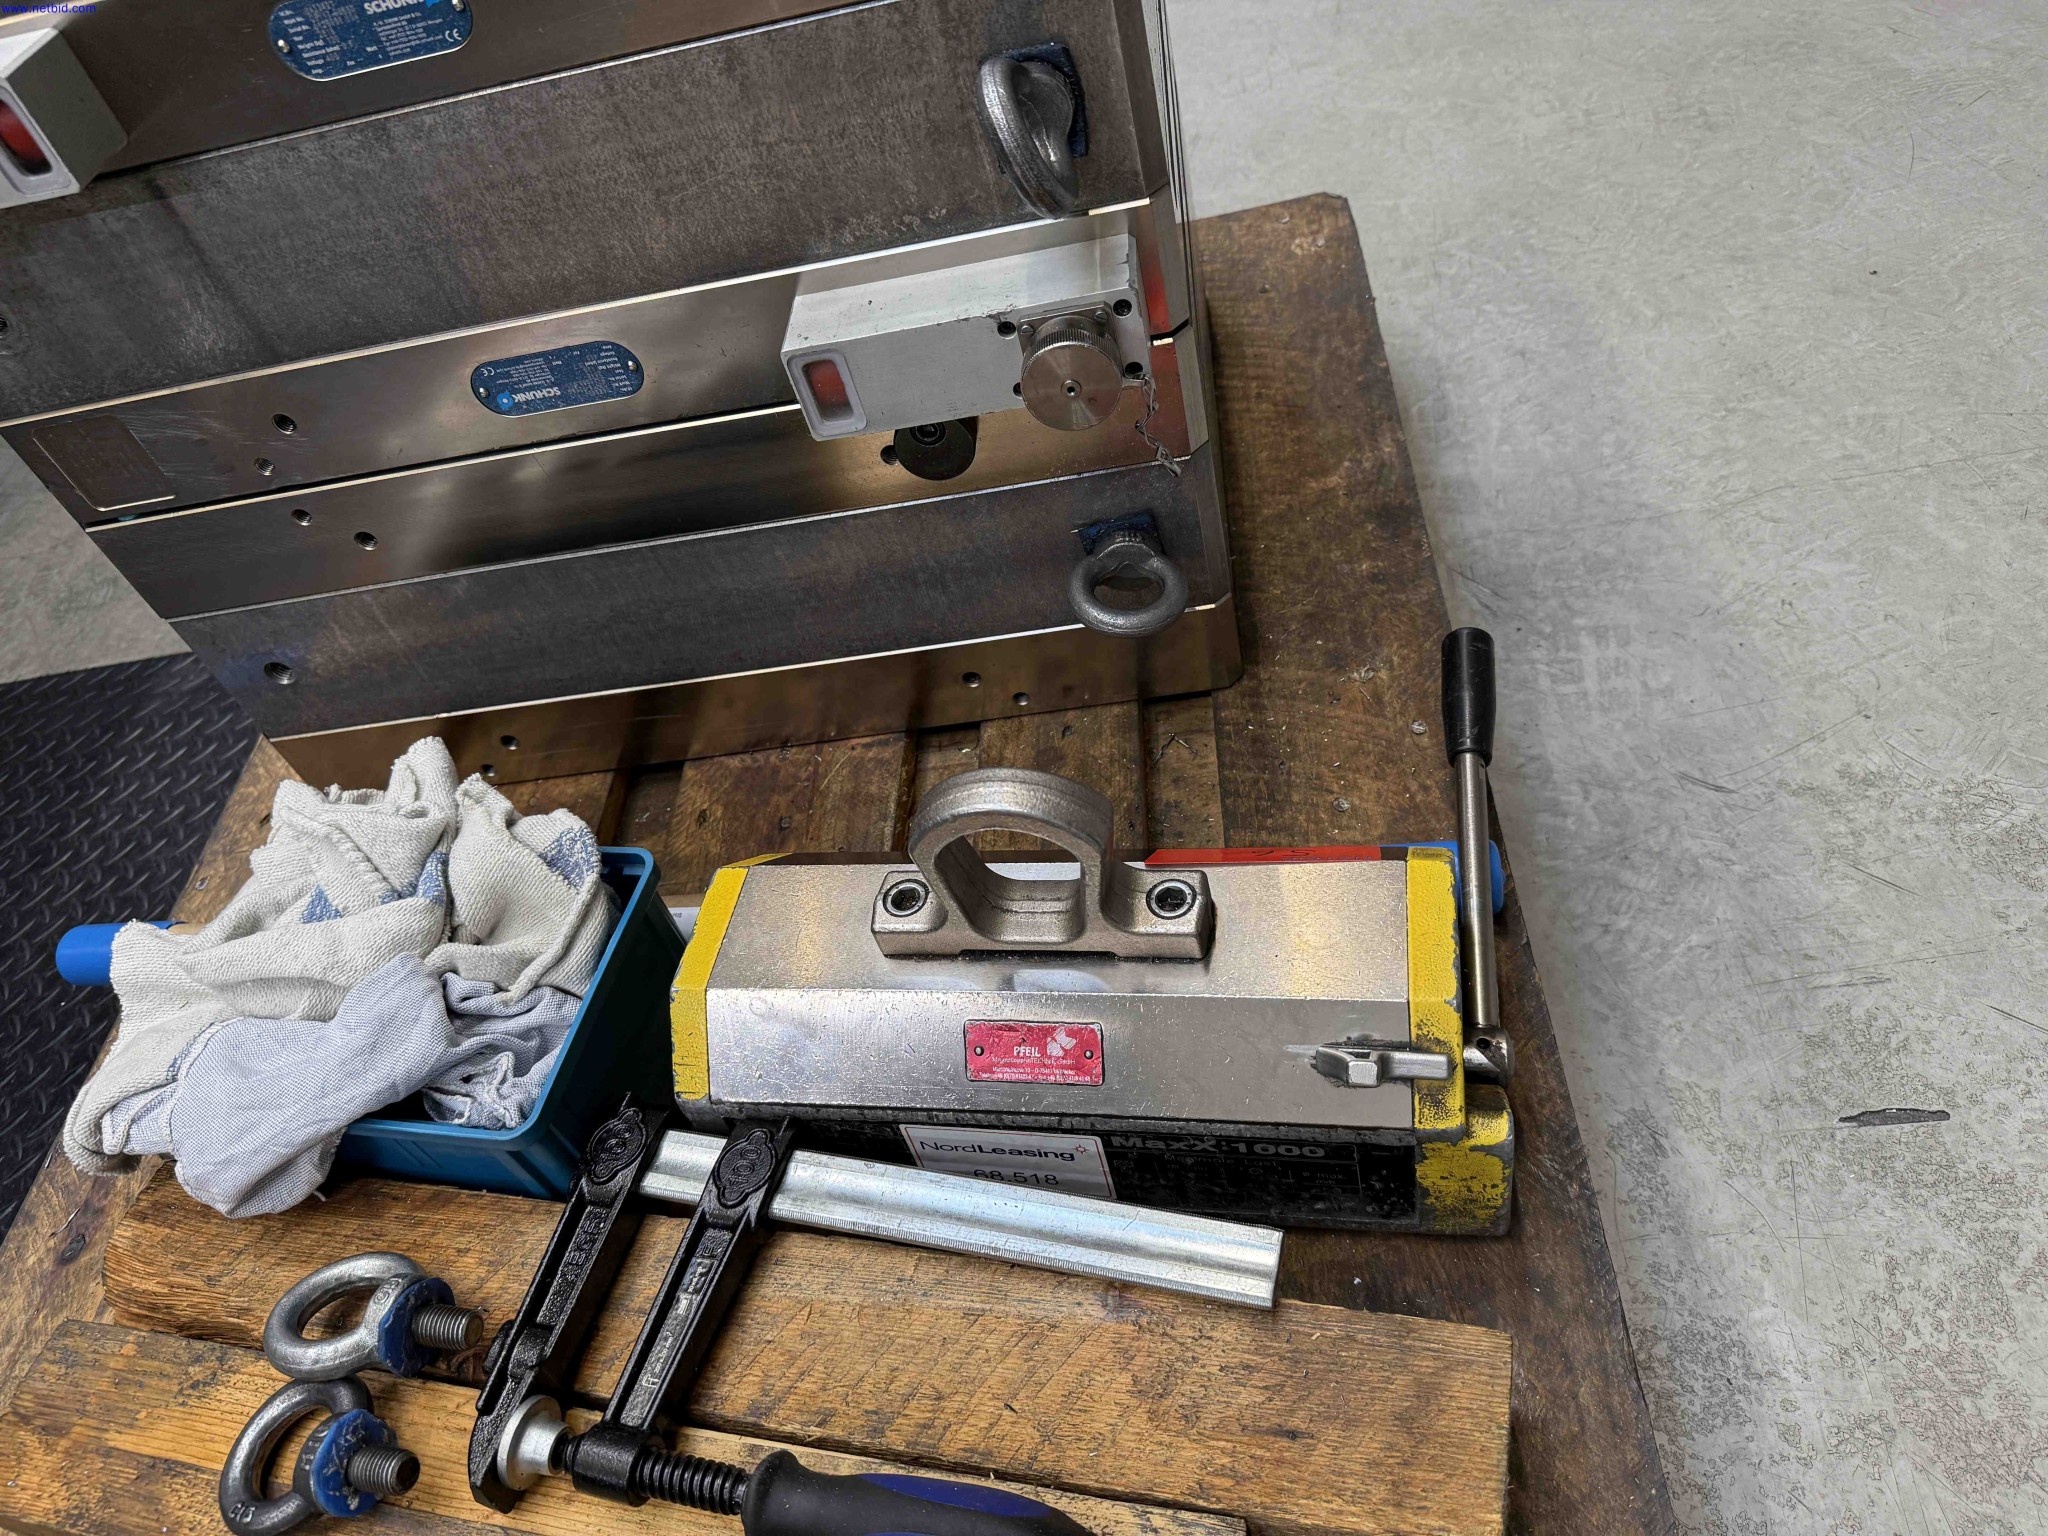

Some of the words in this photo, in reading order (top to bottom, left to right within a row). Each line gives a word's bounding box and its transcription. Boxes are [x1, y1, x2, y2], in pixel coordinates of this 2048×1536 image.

[511, 387, 561, 403] SCHUNK
[1013, 1046, 1041, 1057] PFEIL
[919, 1141, 1076, 1162] NordLeasing
